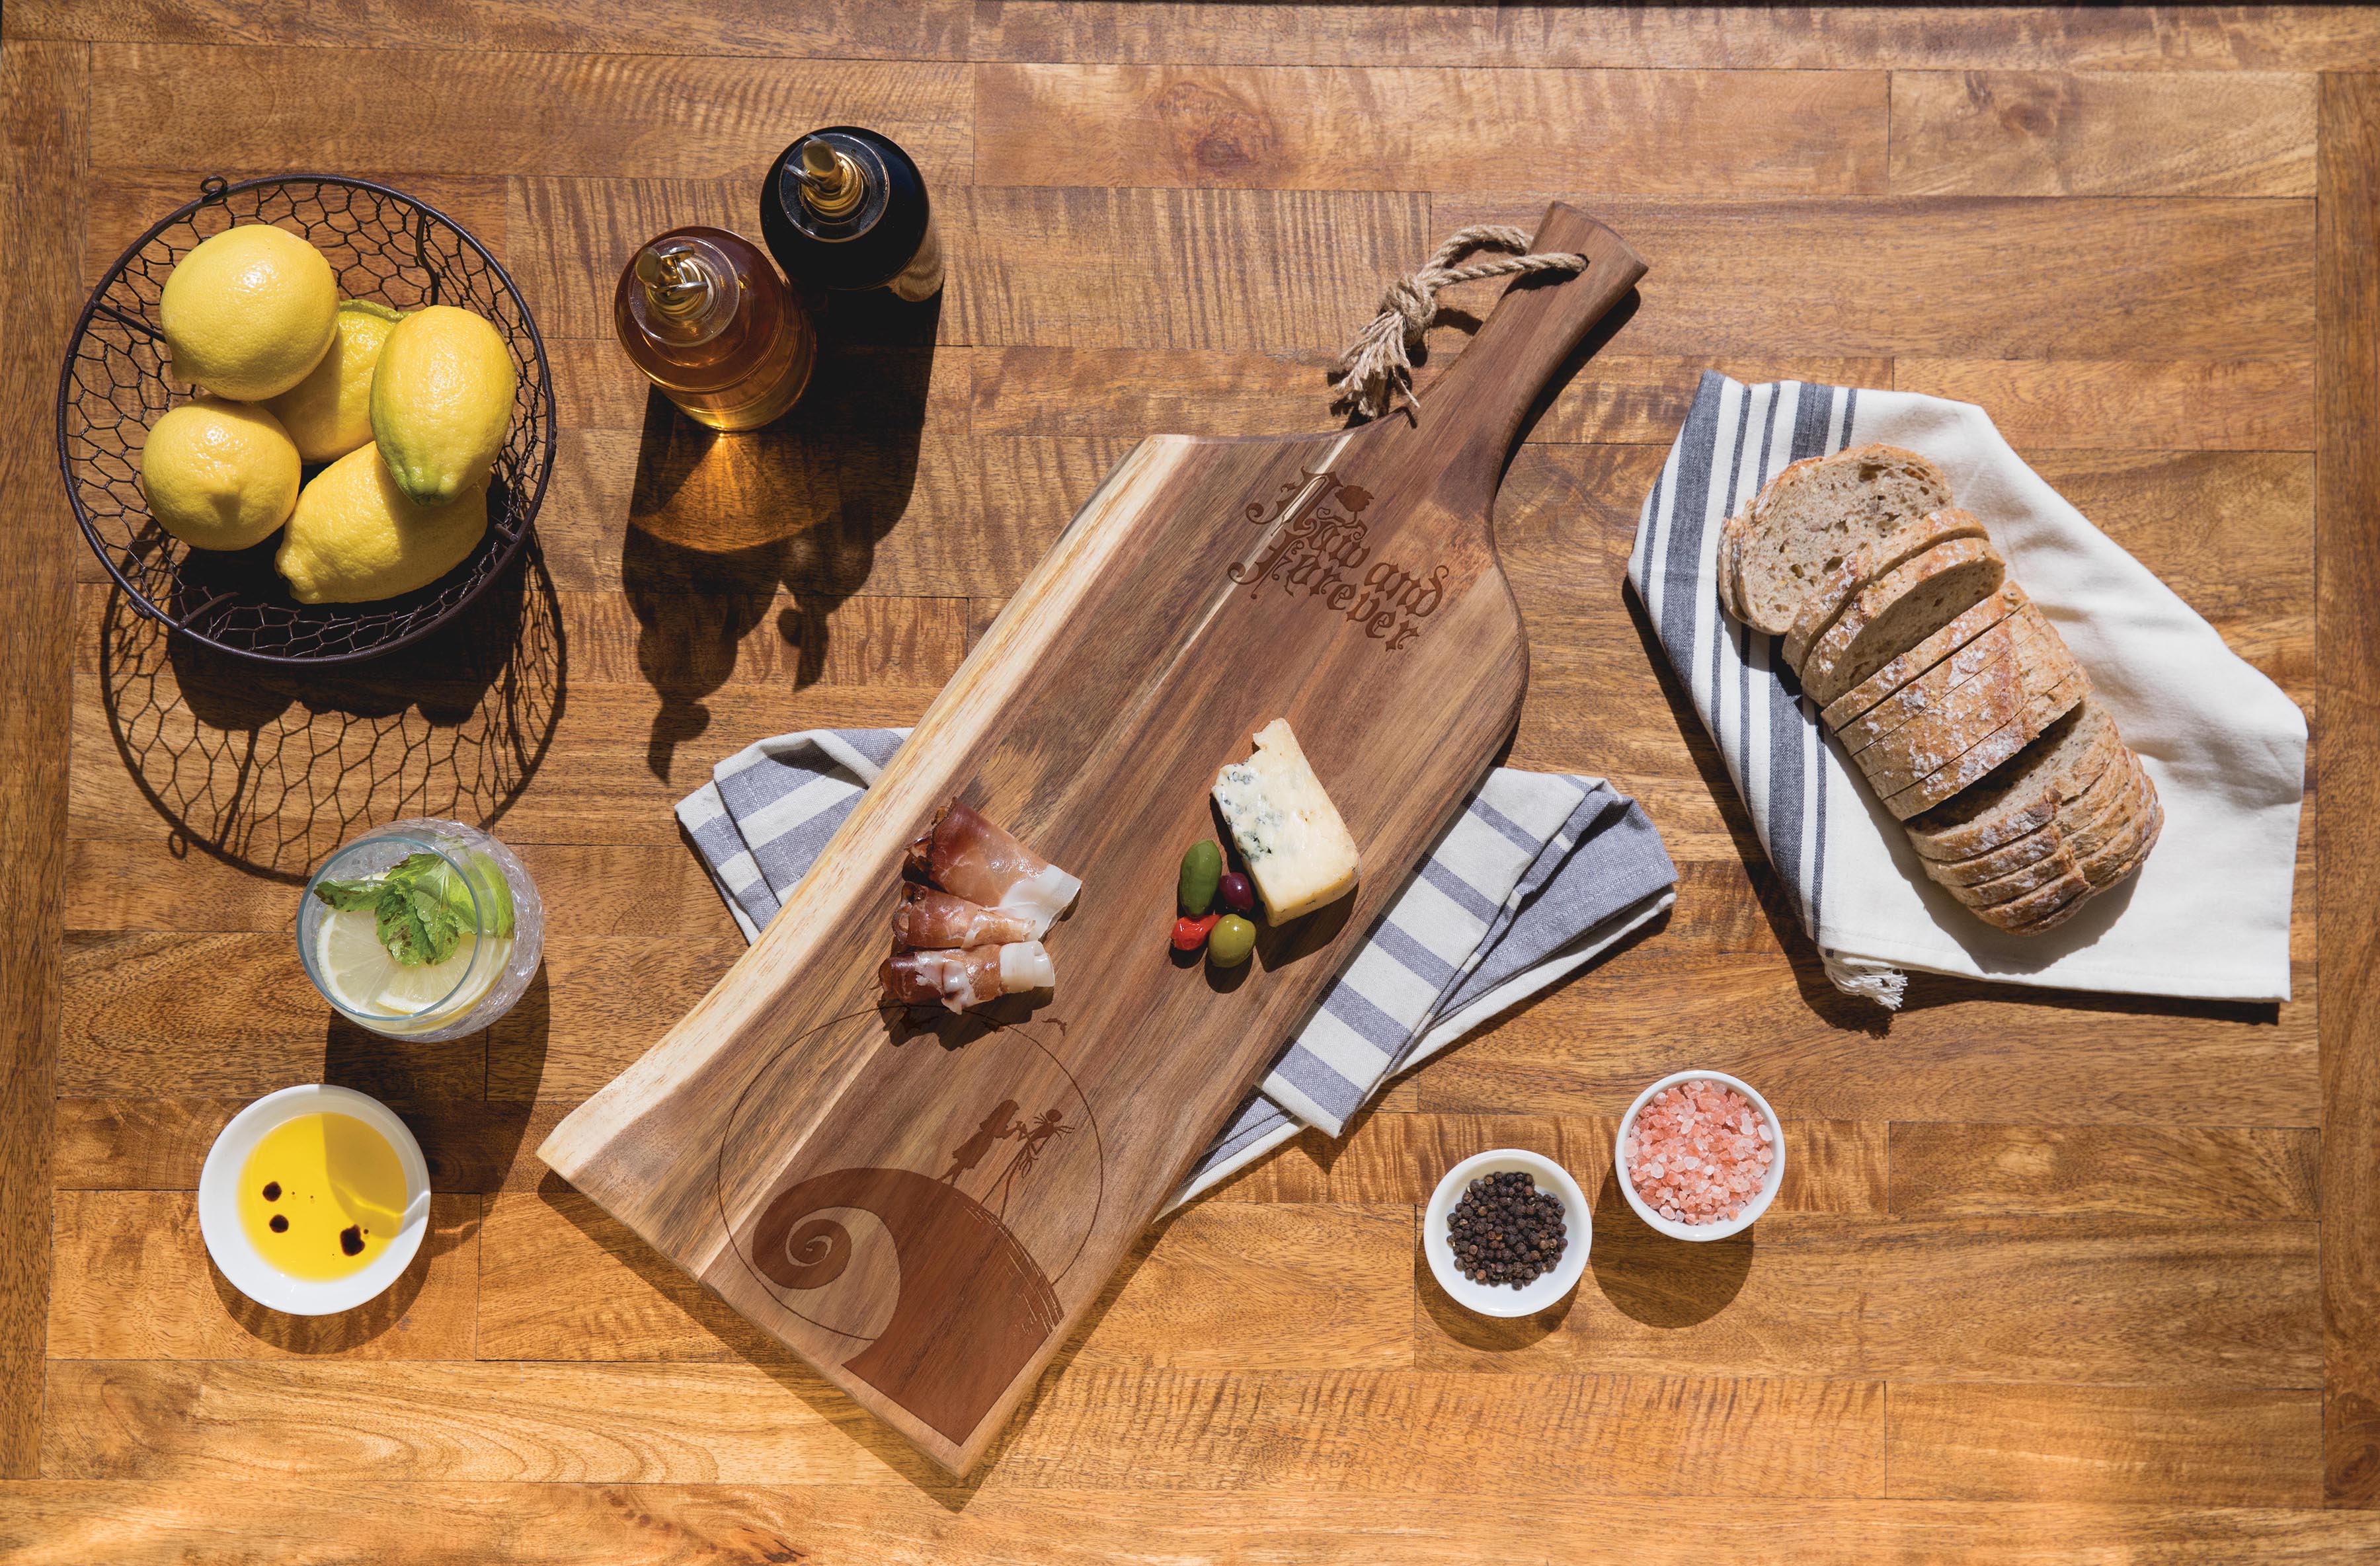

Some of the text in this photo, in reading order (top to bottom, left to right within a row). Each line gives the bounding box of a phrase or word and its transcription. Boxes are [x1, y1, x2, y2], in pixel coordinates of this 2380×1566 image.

[1227, 529, 1419, 652] Forever
[1246, 465, 1449, 617] Now and
